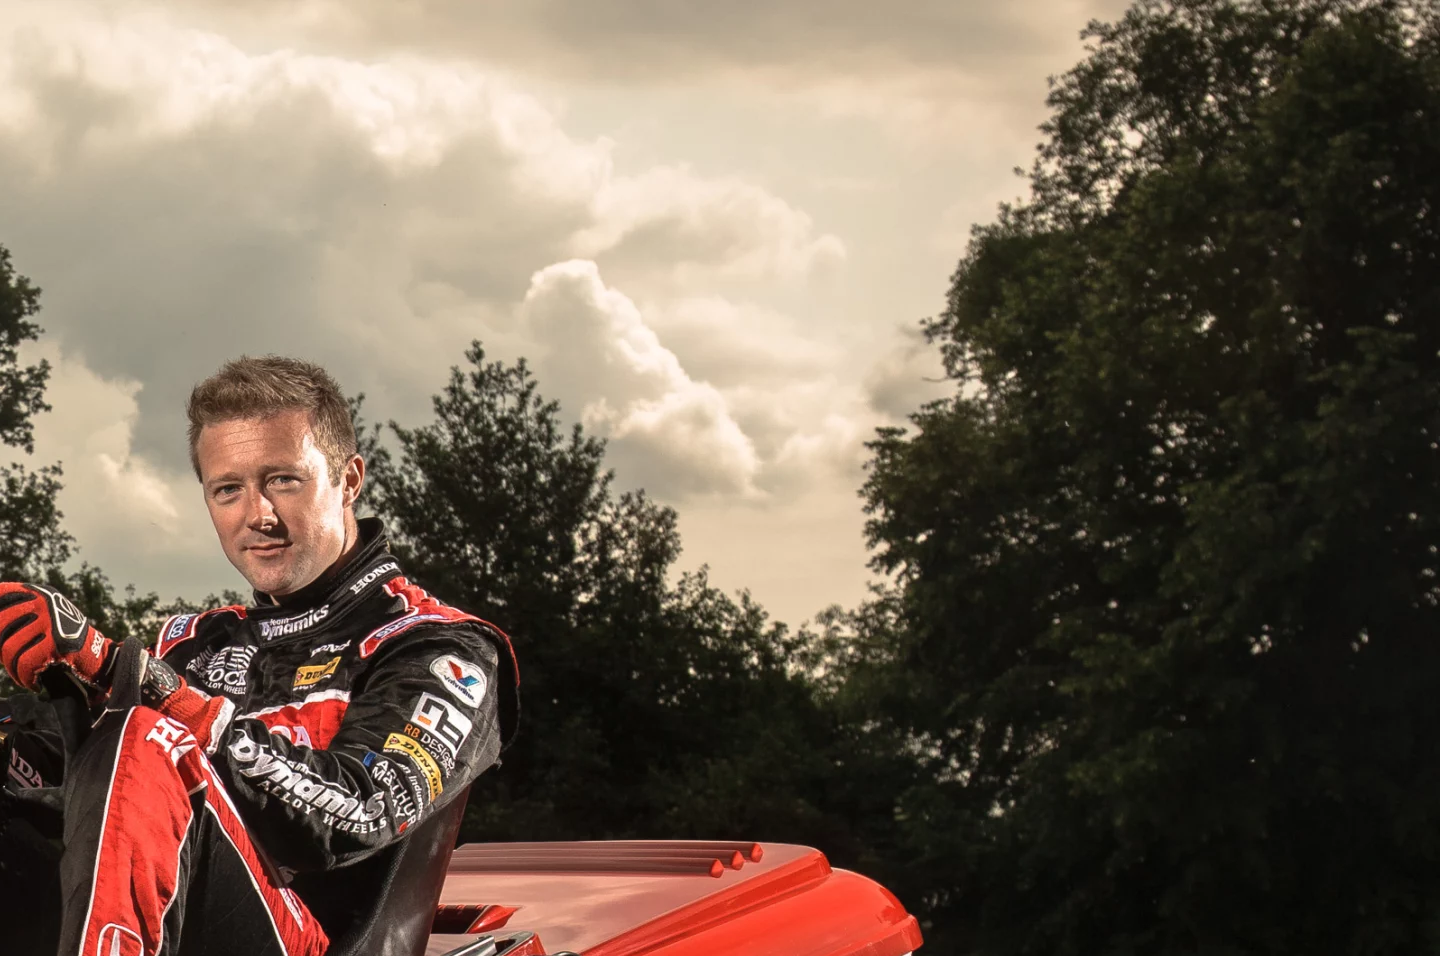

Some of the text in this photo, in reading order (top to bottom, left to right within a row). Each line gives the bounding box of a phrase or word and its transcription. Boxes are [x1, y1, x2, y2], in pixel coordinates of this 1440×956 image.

[259, 604, 329, 640] Dynamics
[404, 723, 421, 737] RB
[227, 729, 386, 822] Dynams
[258, 780, 388, 834] ALLOY WHEELS
